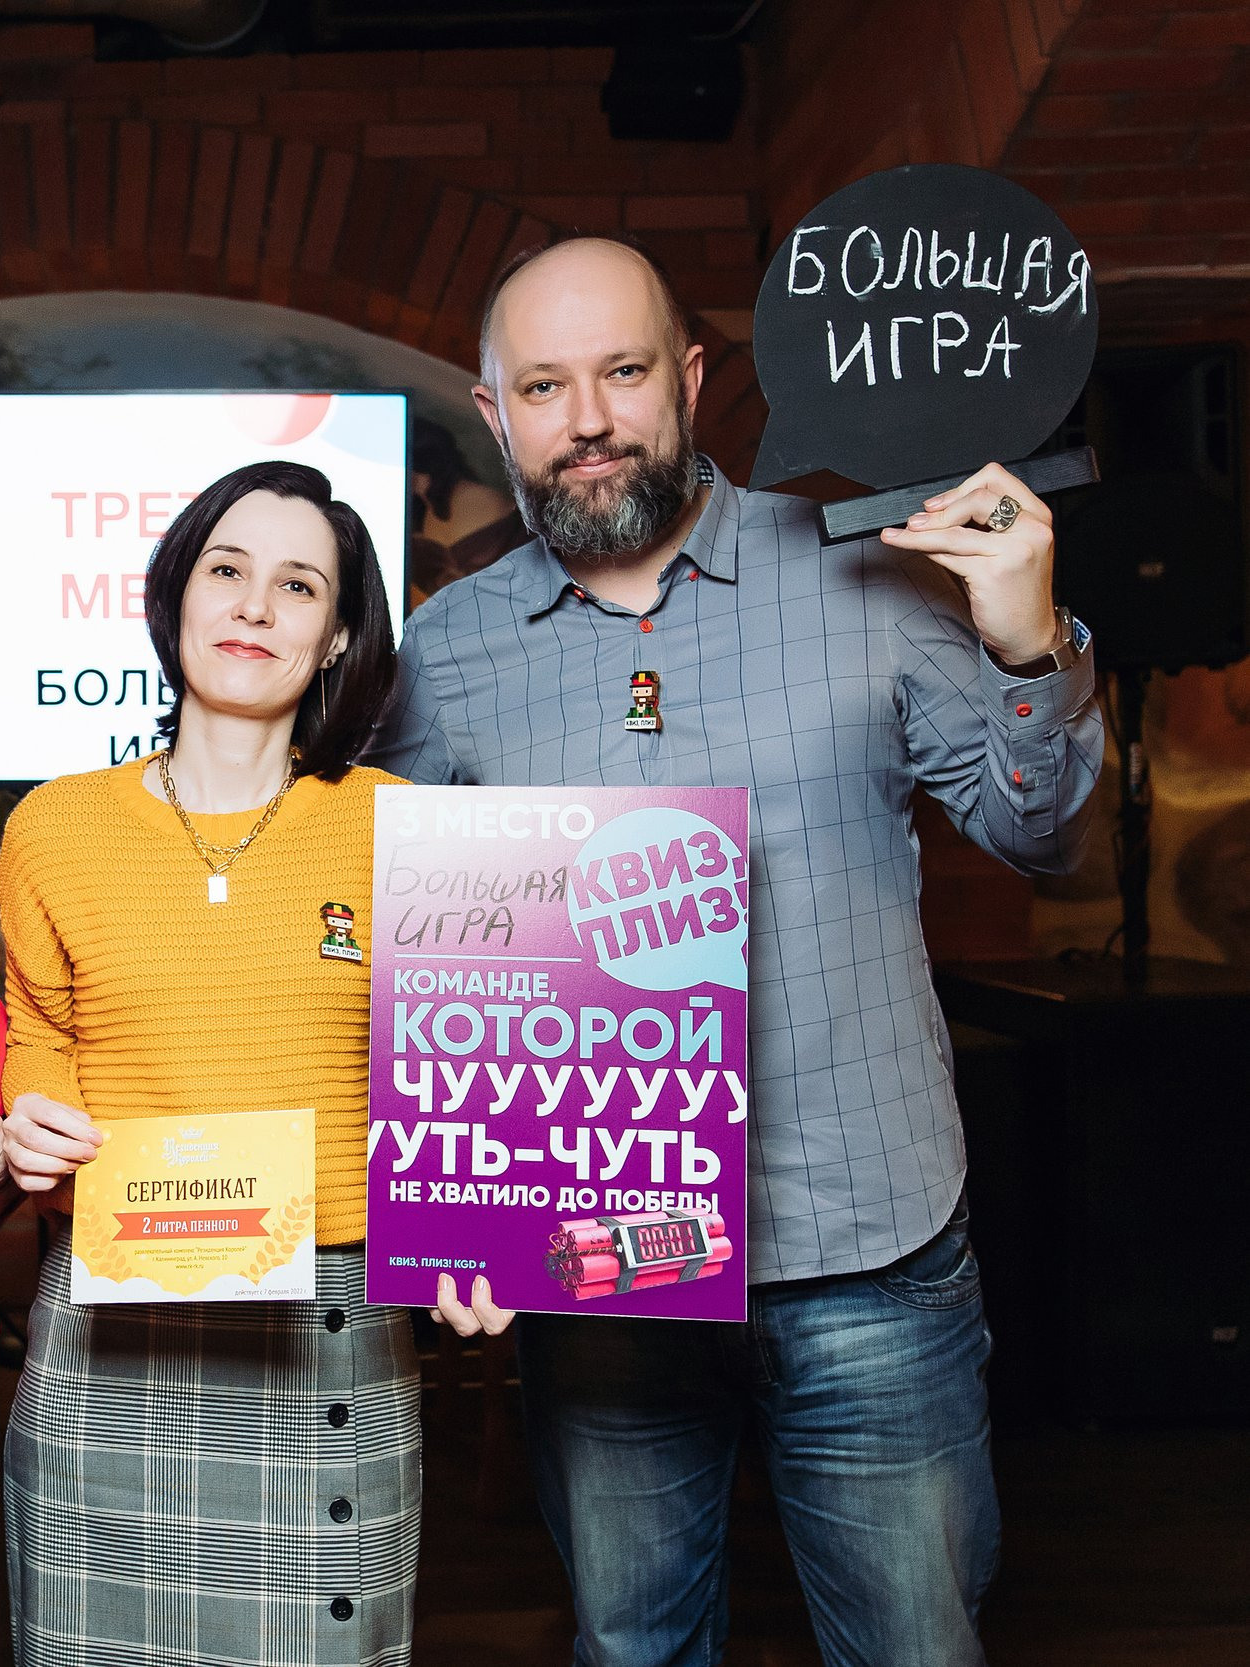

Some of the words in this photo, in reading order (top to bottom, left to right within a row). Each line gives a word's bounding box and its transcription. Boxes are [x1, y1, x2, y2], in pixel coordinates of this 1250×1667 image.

[789, 225, 1091, 314] БОЛЬШАЯ
[826, 311, 1022, 386] ИГРА
[396, 802, 421, 838] 3
[435, 803, 595, 841] МЕСТО
[393, 969, 558, 1003] КОМАНДЕ,
[393, 996, 723, 1063] КОТОРОЙ
[127, 1178, 257, 1203] СЕРТИФИКАТ
[389, 1180, 422, 1203] НЕ
[427, 1182, 551, 1208] ХВАТИЛО
[555, 1186, 598, 1212] ДО
[605, 1188, 719, 1214] ПОБЕДЫ
[142, 1217, 151, 1234] 2
[154, 1221, 188, 1233] ЛИТРА
[190, 1219, 239, 1233] ПЕННОГО
[637, 1223, 696, 1261] 00:01
[389, 1256, 419, 1268] КВИЗ,
[421, 1258, 452, 1268] ПЛИЗ!
[454, 1259, 477, 1269] KGD
